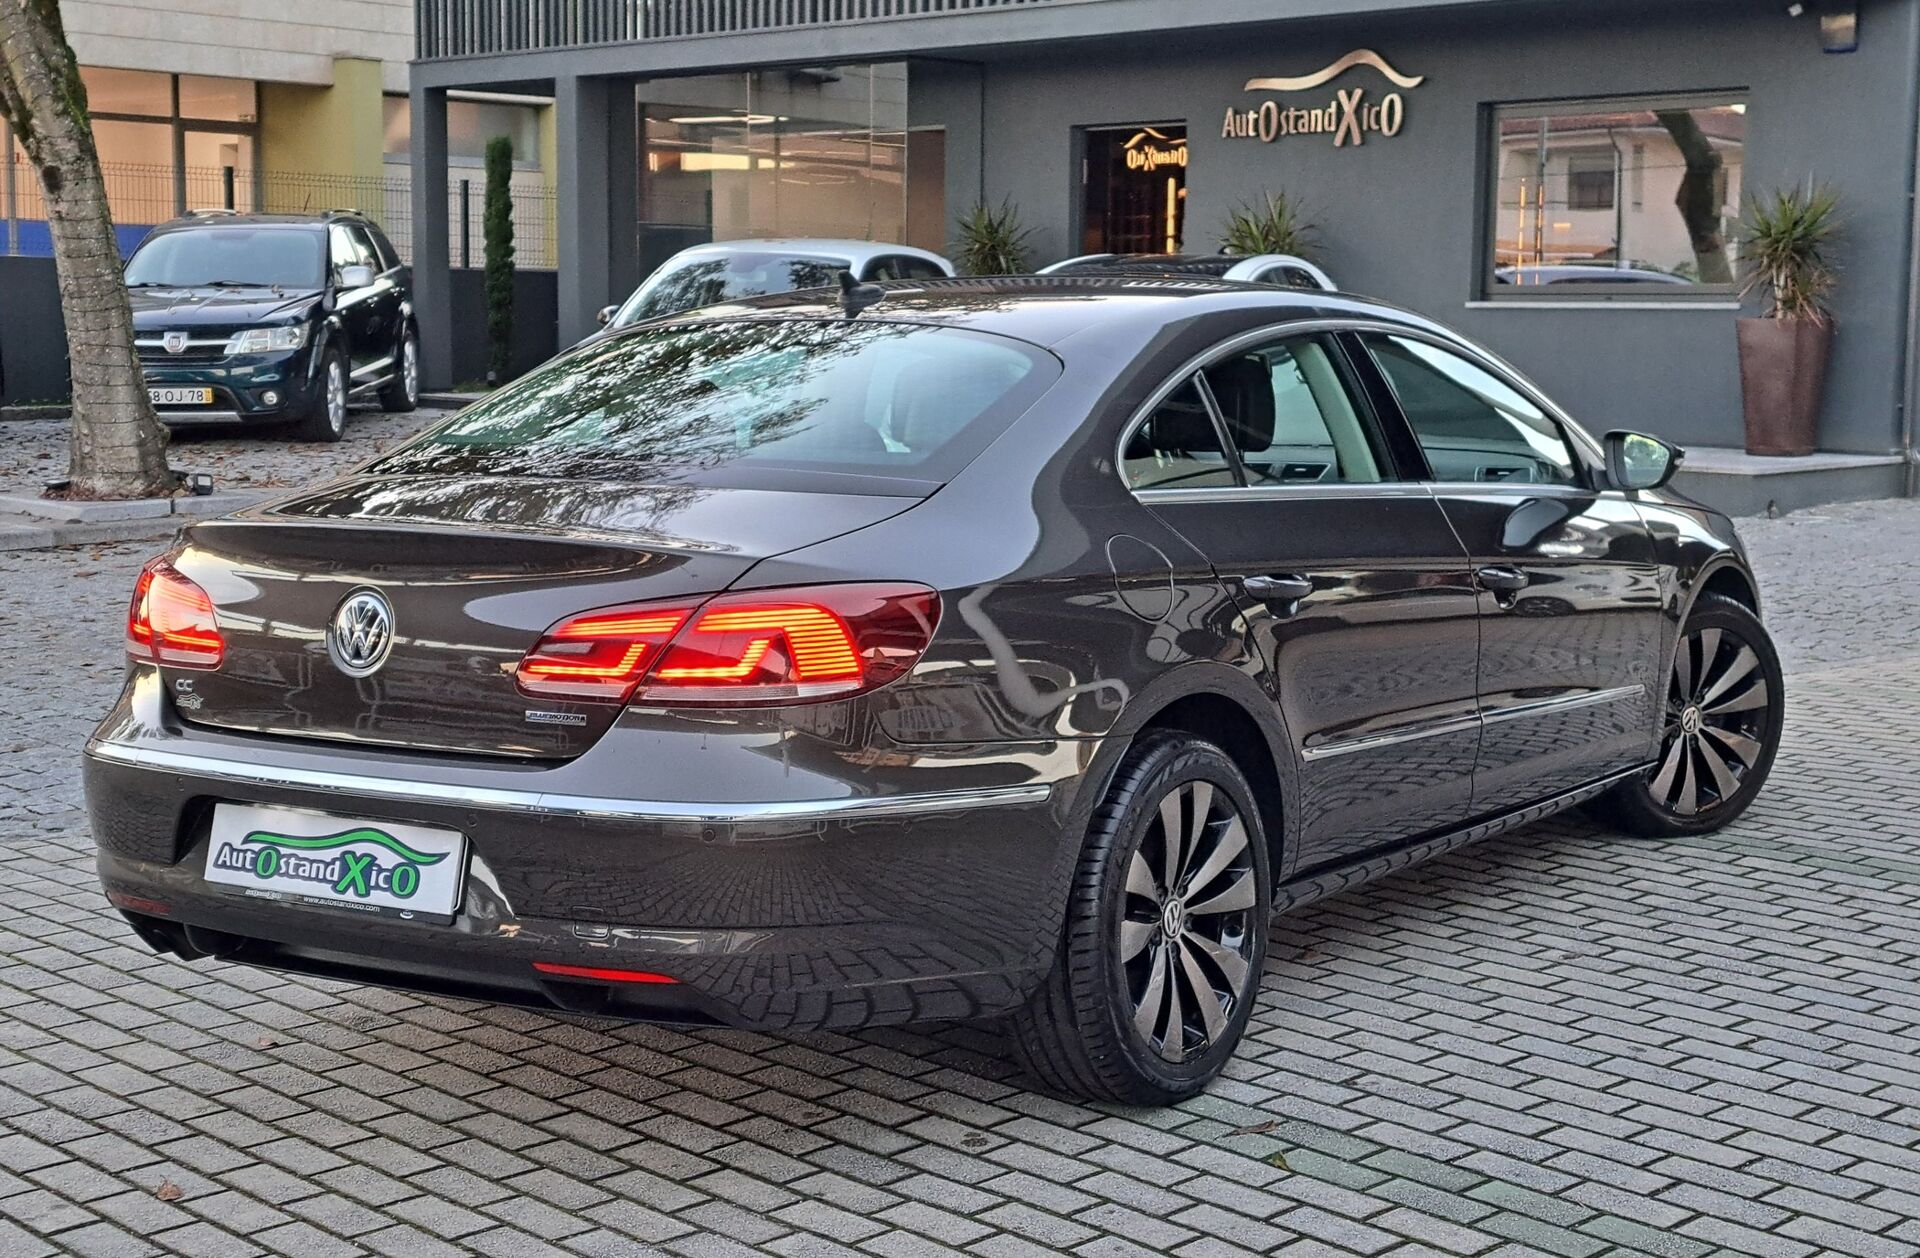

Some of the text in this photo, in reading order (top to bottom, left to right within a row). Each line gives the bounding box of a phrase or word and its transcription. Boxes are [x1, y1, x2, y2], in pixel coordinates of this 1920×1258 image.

[1222, 88, 1403, 147] AutOstandXicO
[149, 390, 203, 402] 8-OJ-78
[176, 679, 193, 692] CC
[215, 844, 418, 896] AutOstandXicO
